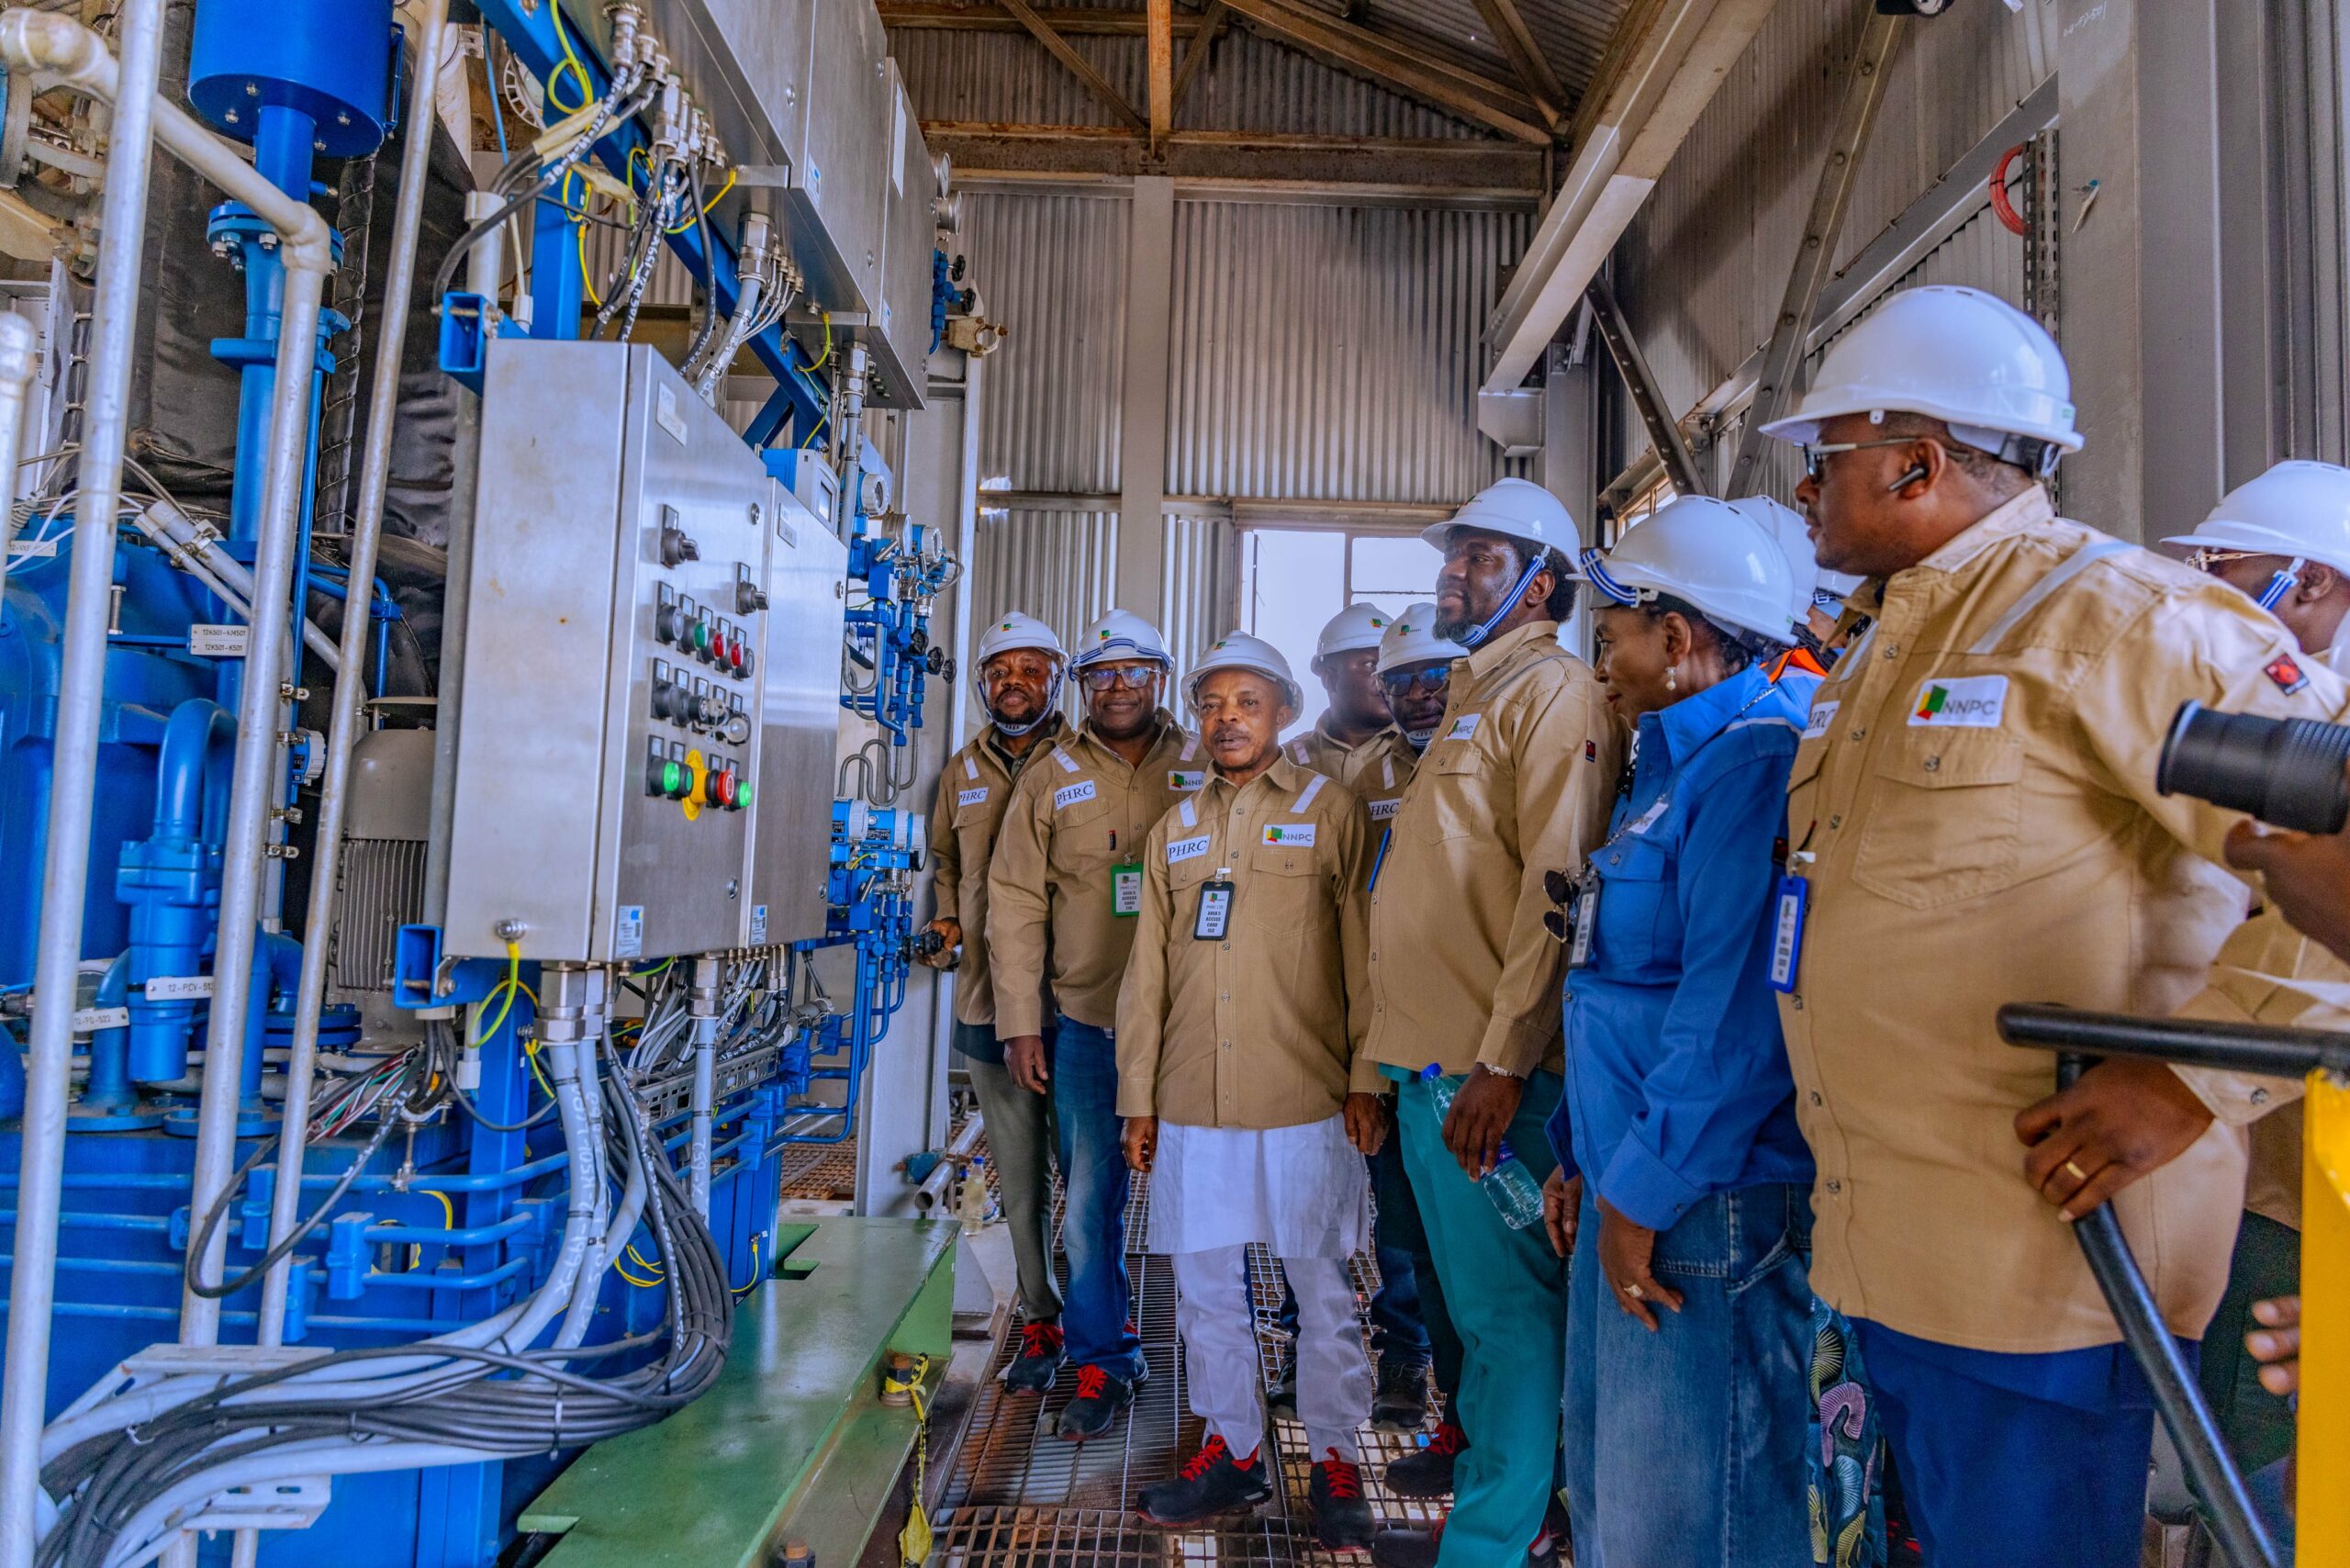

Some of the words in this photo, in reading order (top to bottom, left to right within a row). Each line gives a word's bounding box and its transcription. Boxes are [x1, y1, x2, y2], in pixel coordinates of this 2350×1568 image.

[1941, 699, 1996, 717] NNPC
[1807, 708, 1836, 730] HRC
[1183, 778, 1203, 788] NNP
[1057, 784, 1094, 805] PHRC
[1371, 801, 1401, 817] HRC
[1282, 833, 1314, 842] NNPC
[1169, 839, 1207, 858] PHRC
